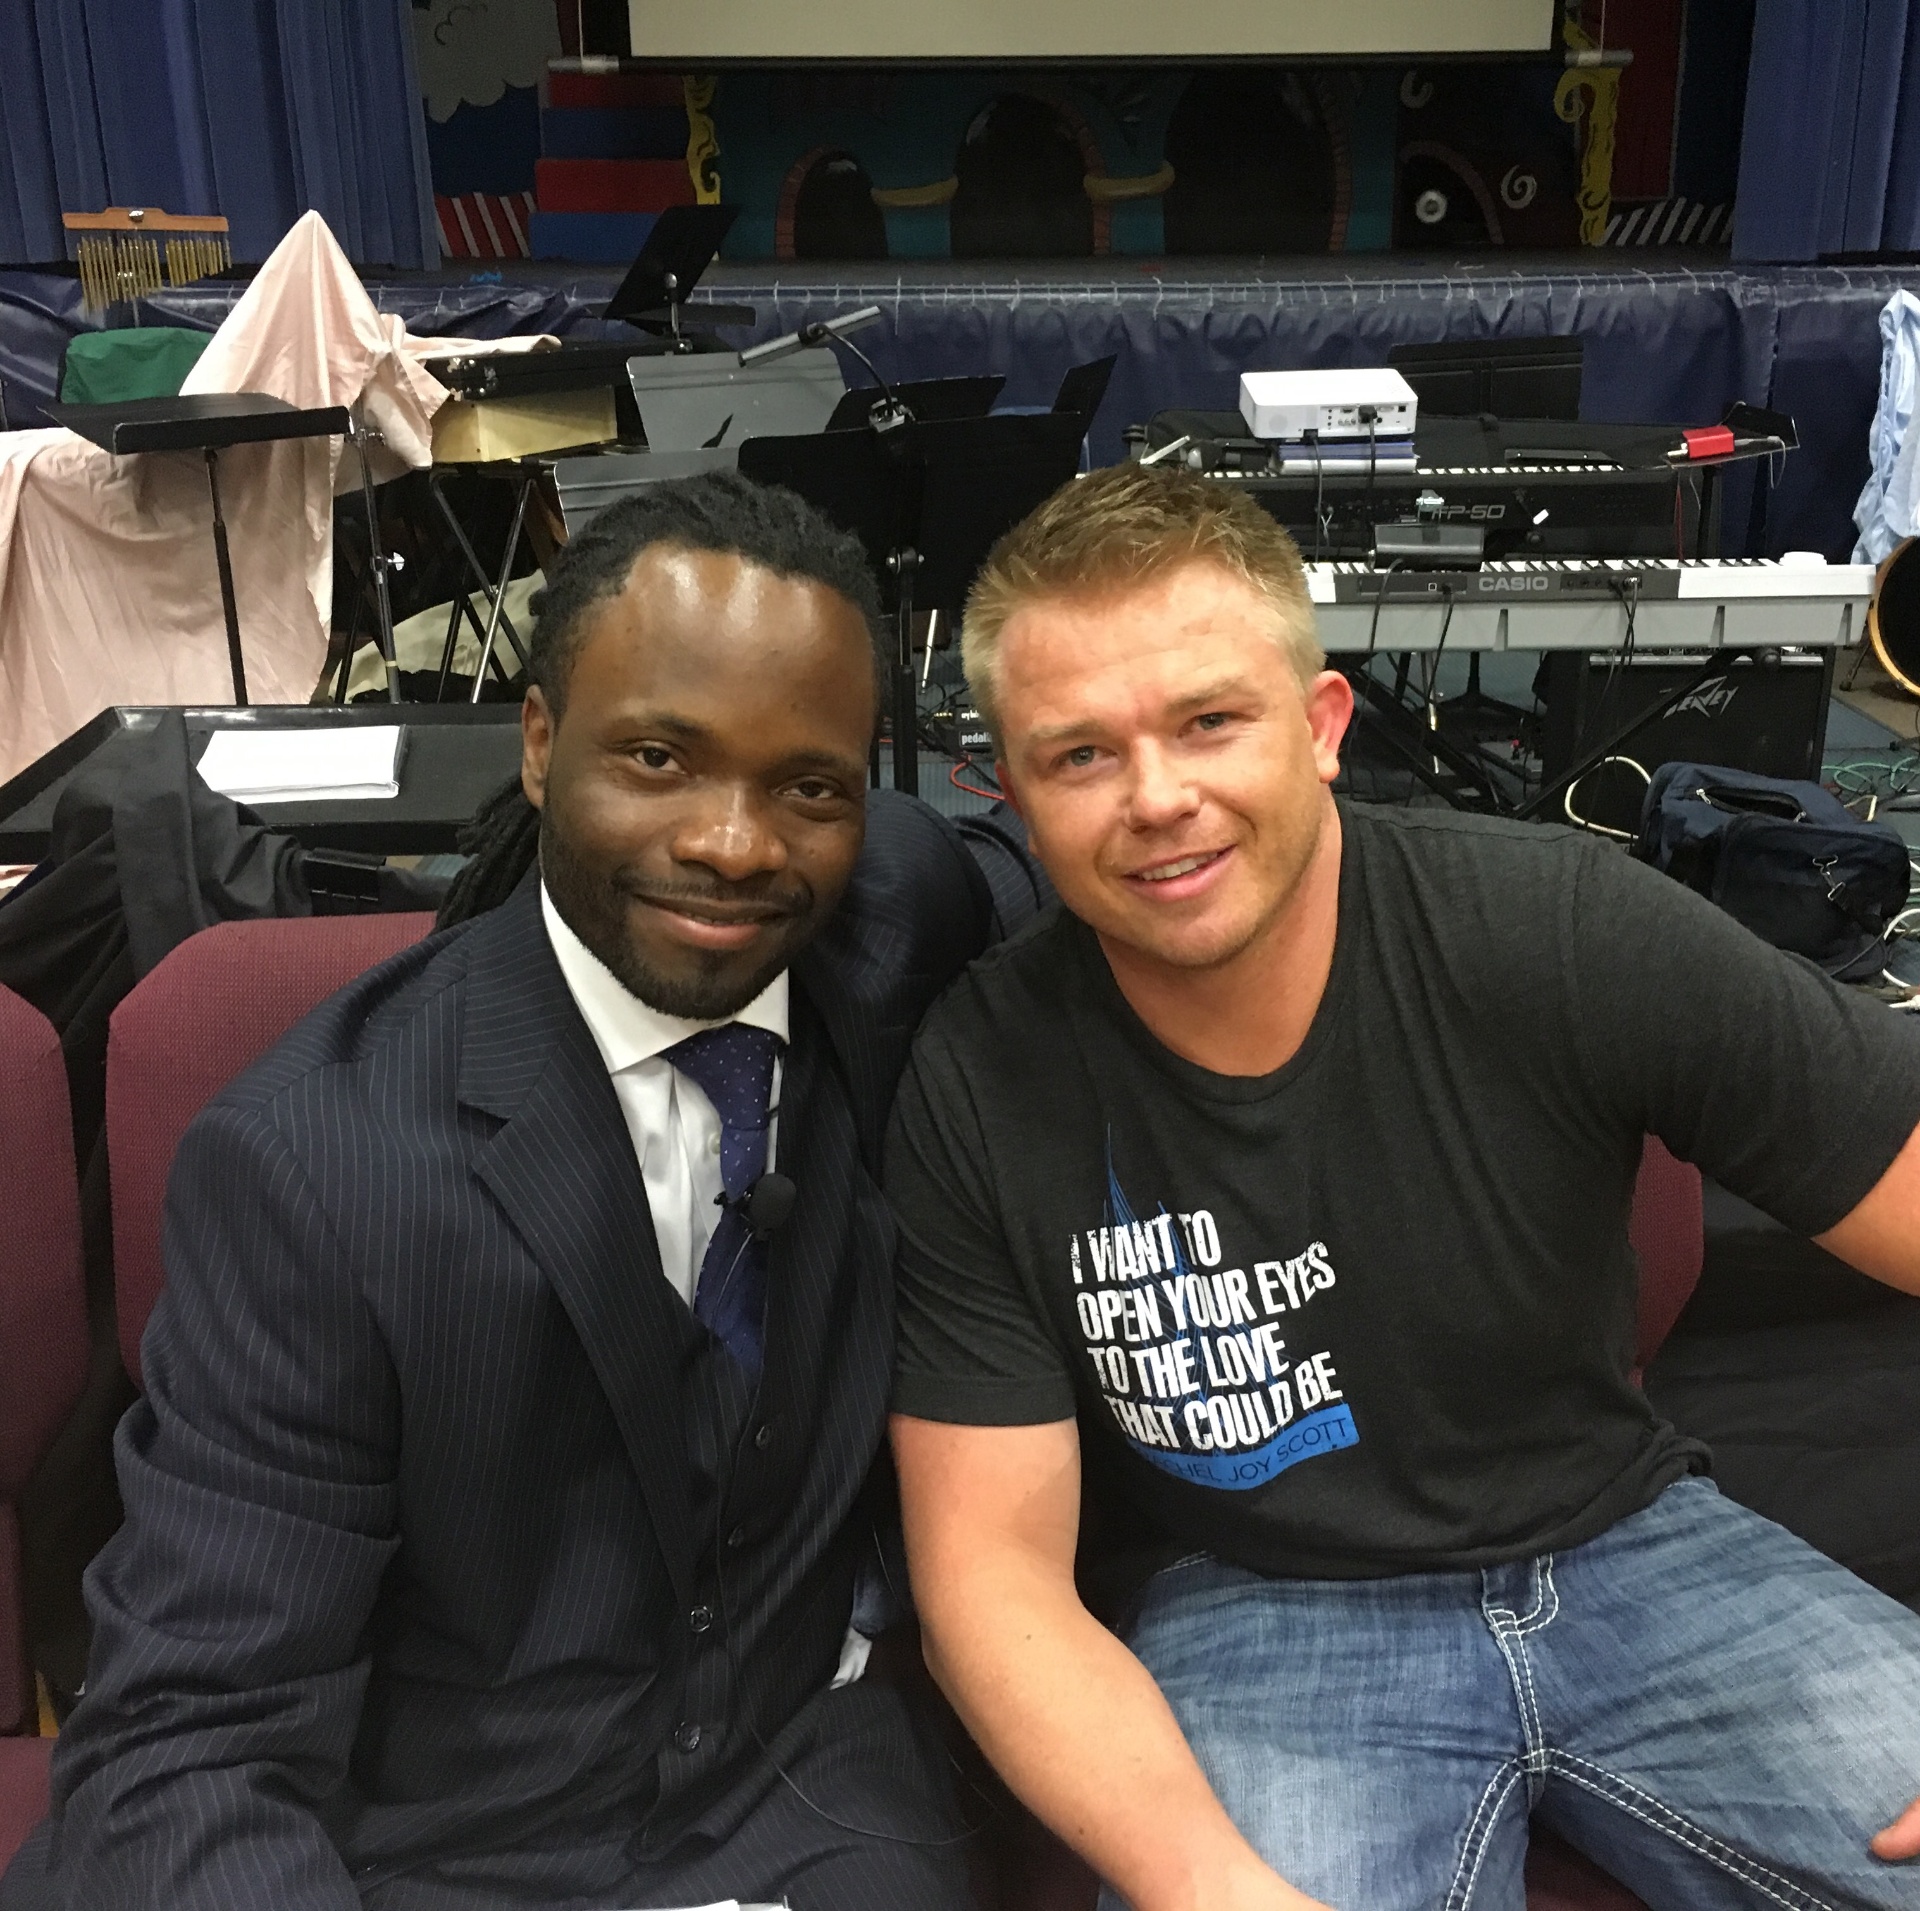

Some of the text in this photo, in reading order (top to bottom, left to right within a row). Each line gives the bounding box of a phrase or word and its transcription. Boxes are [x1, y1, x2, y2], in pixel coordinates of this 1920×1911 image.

[1432, 505, 1505, 520] FP-50
[1479, 576, 1549, 592] CASIO
[961, 732, 991, 746] pedal
[1069, 1209, 1222, 1284] I WANT TO
[1076, 1240, 1336, 1342] OPEN YOUR EYES
[1087, 1321, 1290, 1398] TO THE LOVE
[1102, 1351, 1344, 1450] THAT COULD BE
[1228, 1455, 1271, 1483] JOY
[1276, 1417, 1347, 1463] SCOTT
